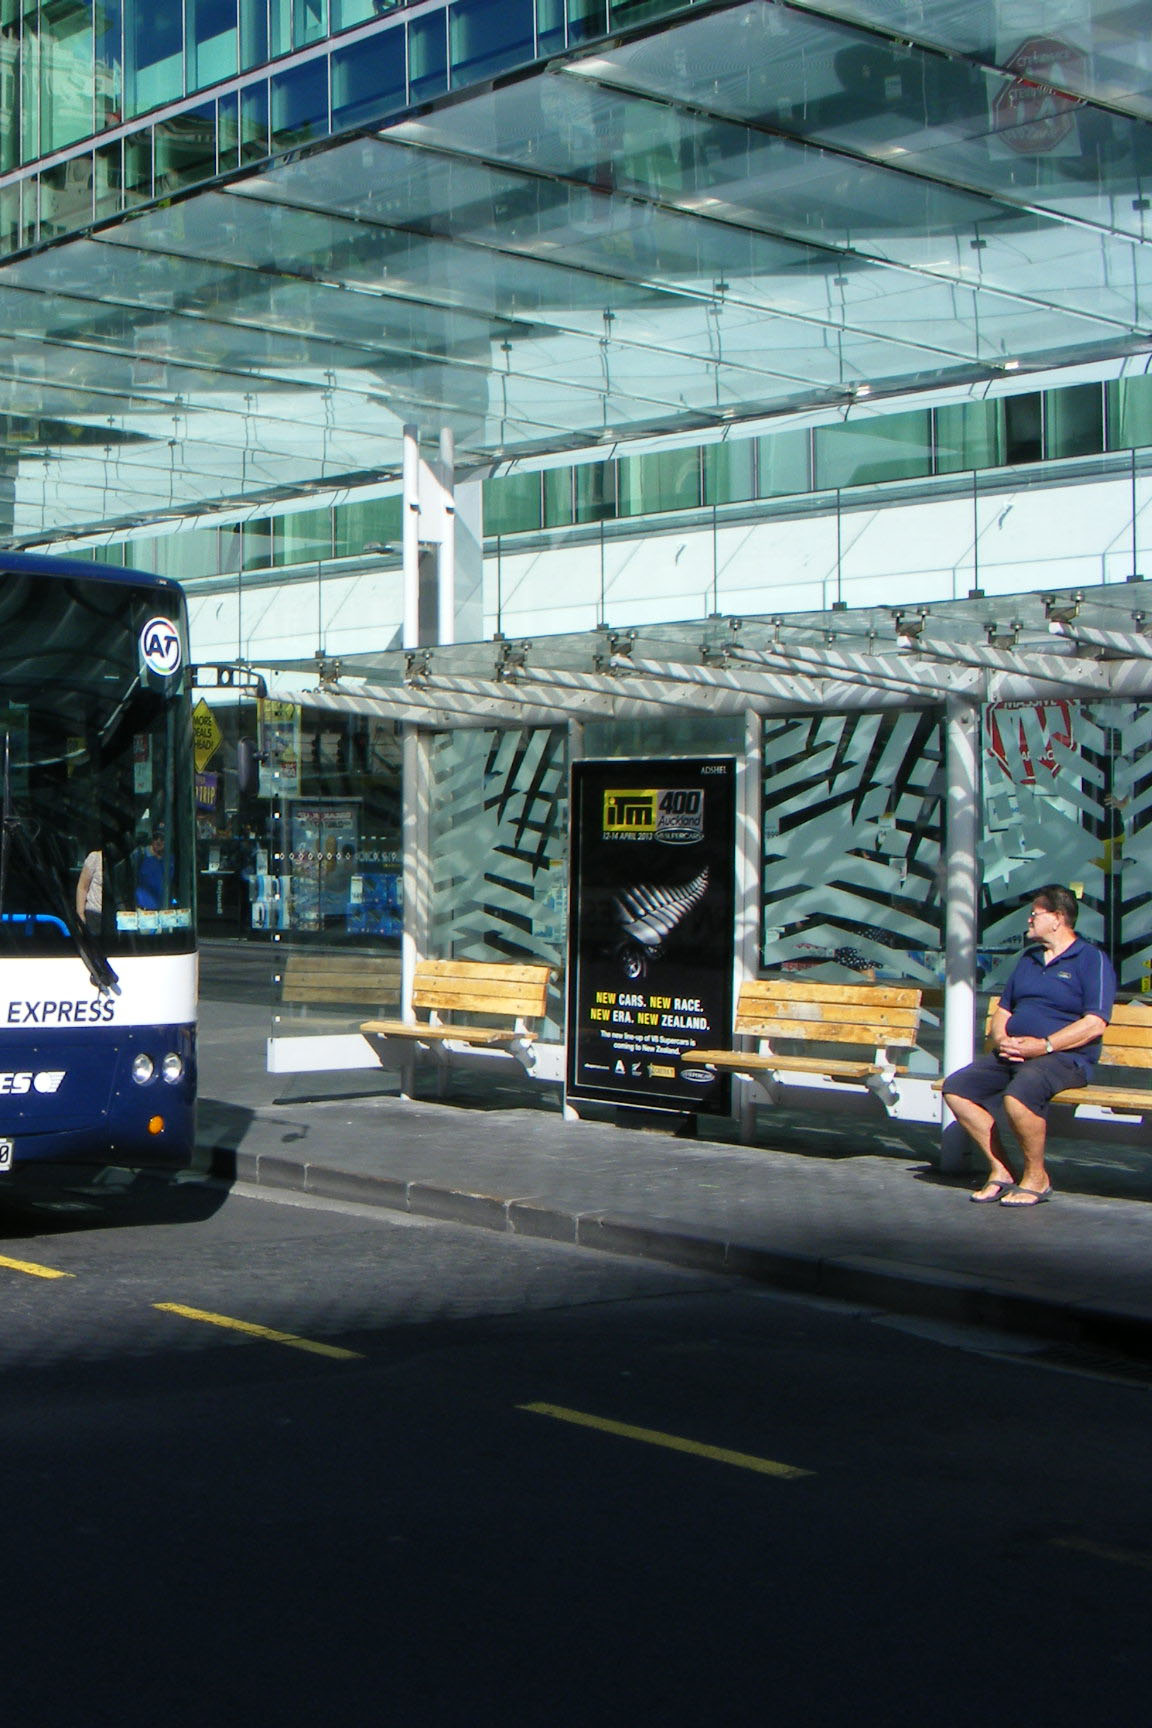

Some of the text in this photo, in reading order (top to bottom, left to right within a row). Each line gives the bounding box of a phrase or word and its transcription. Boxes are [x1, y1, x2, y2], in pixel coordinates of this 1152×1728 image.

[146, 634, 178, 657] AT
[659, 791, 701, 814] 400
[658, 814, 701, 827] Auckland
[619, 832, 636, 840] APRIL
[7, 1000, 115, 1023] EXPRESS
[596, 992, 704, 1012] NEW CARS. NEW RACE.
[590, 1008, 710, 1030] NEW ERA. NEW ZEALAND.
